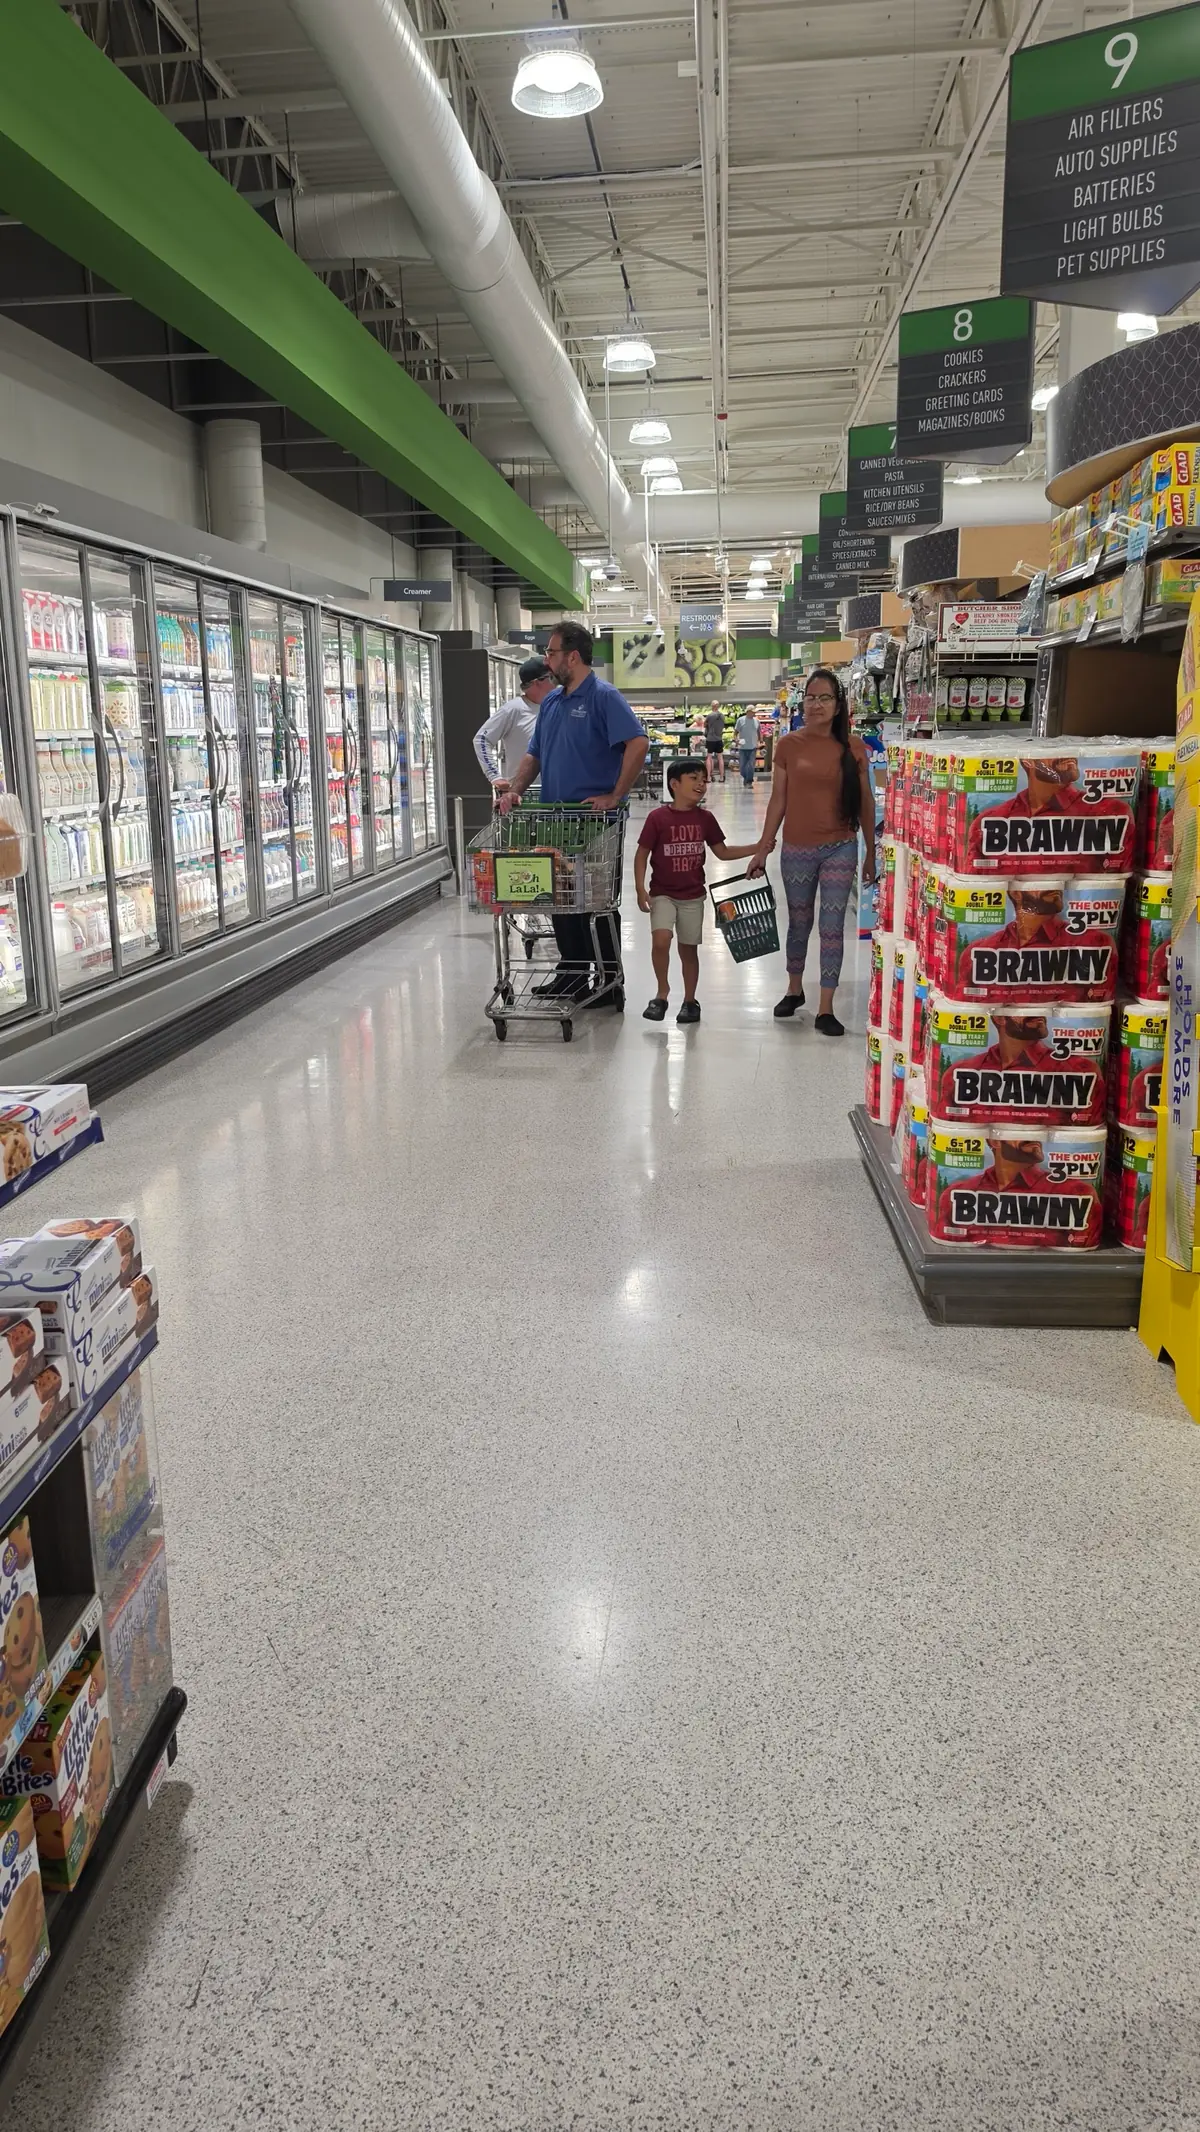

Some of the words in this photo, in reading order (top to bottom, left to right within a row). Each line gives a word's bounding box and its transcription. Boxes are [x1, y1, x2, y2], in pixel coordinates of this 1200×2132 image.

[1104, 32, 1138, 89] 9
[1068, 114, 1094, 140] AIR
[1101, 98, 1163, 132] FILTERS
[1055, 150, 1094, 177] AUTO
[1100, 130, 1178, 167] SUPPLIES
[1073, 171, 1155, 208] BATTERIES
[1064, 215, 1107, 243] LIGHT
[1112, 205, 1163, 234] BULBS
[1057, 253, 1084, 277] PET
[1089, 238, 1165, 272] SUPPLIES
[953, 309, 973, 341] 8
[944, 349, 983, 367] COOKIES
[938, 369, 986, 388] CRACKERS
[925, 392, 970, 411] GREETING
[973, 388, 1003, 404] CARDS
[918, 408, 1005, 432] MAGAZINES/BOOKS
[888, 426, 897, 450] 7
[860, 458, 886, 470] CANNED
[1178, 452, 1189, 483] GLAD
[884, 471, 904, 482] PASTA
[863, 488, 891, 499] KITCHEN
[893, 483, 924, 495] UTENSILS
[865, 501, 896, 513] RICE/DRY
[897, 499, 919, 510] BEANS
[1173, 494, 1184, 525] GLAD
[867, 513, 916, 527] SAUCES/MIXES
[832, 538, 875, 549] OIL/SHORTENING
[832, 549, 876, 560] SPICES/EXTRACTS
[836, 562, 856, 571] CANNED
[857, 561, 870, 569] MILK
[1183, 564, 1200, 573] GLA
[403, 587, 432, 595] Creamer
[681, 614, 722, 622] RESTROOMS
[1177, 702, 1193, 733] GLAD
[1085, 770, 1107, 778] THE
[1109, 768, 1136, 777] ONLY
[670, 825, 702, 841] LOVE
[984, 818, 1127, 853] BRAWNY
[672, 856, 702, 872] HATE
[1069, 902, 1091, 910] THE
[1093, 901, 1119, 910] ONLY
[974, 949, 1109, 981] BRAWNY
[1175, 955, 1184, 1016] 30%
[1053, 1029, 1075, 1037] THE
[1077, 1029, 1104, 1038] ONLY
[1146, 1018, 1167, 1032] 6=1
[1182, 984, 1192, 1097] HOLDS
[956, 1071, 1094, 1105] BRAWNY
[1172, 1028, 1183, 1125] MORE
[1049, 1153, 1070, 1161] THE
[1072, 1153, 1099, 1161] ONLY
[953, 1192, 1090, 1228] BRAWNY
[89, 1276, 104, 1305] mini
[102, 1327, 118, 1358] mini
[14, 1407, 19, 1418] 6
[64, 1700, 88, 1781] Little
[75, 1706, 99, 1783] Bites
[3, 1773, 53, 1797] Bites
